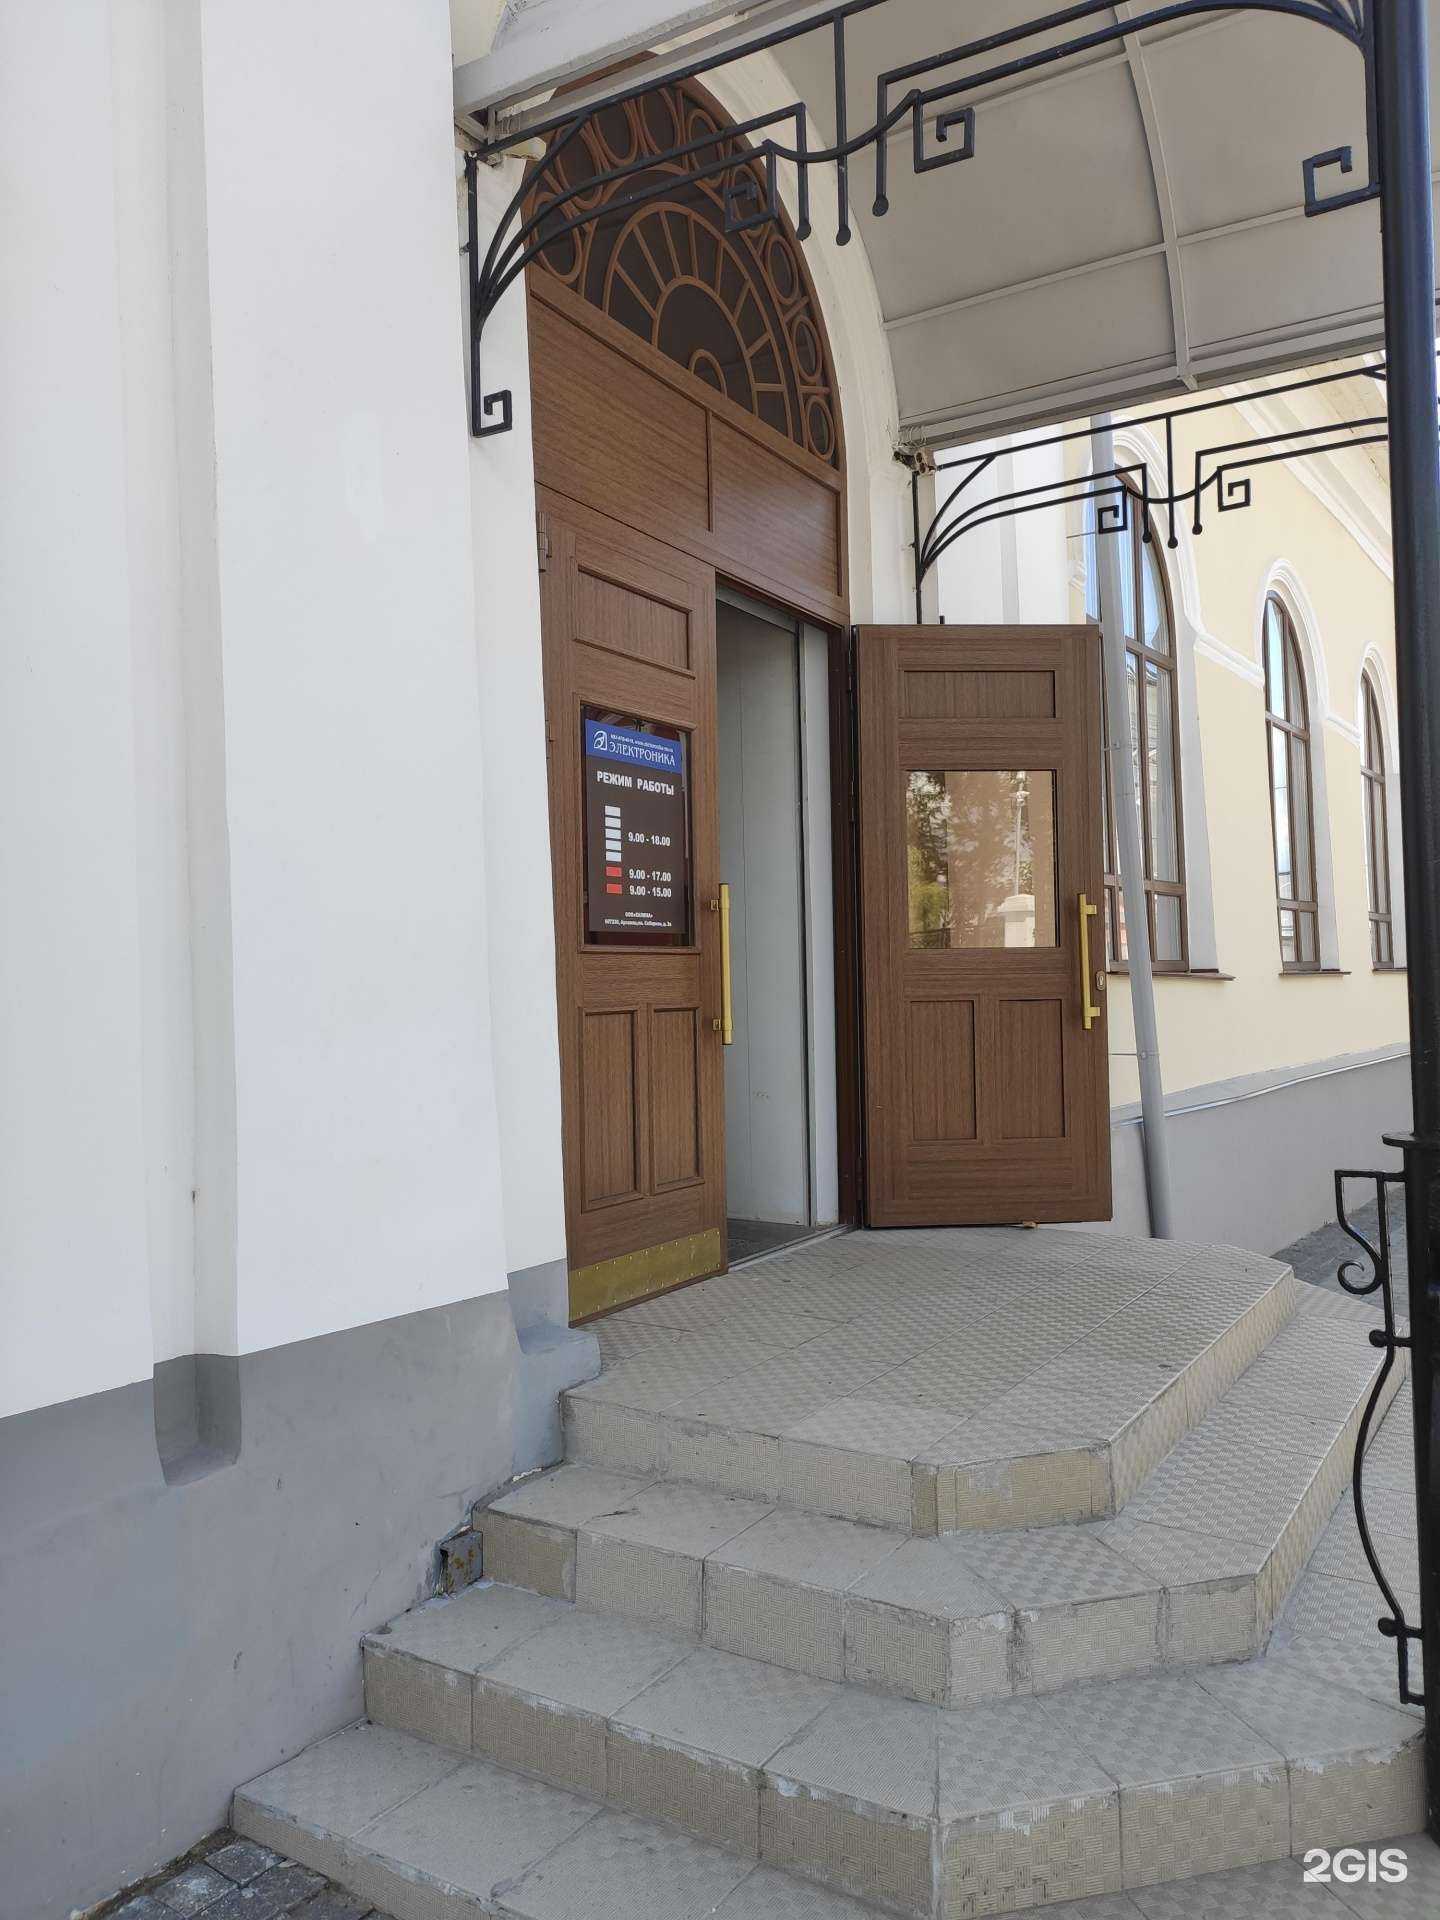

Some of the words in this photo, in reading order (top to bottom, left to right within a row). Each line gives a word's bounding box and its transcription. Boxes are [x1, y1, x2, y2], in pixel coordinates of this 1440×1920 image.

[609, 741, 676, 767] ЭЛЕКТРОНИКА
[597, 770, 633, 788] РЕЖИМ
[637, 778, 674, 796] РАБОТЫ
[628, 831, 645, 843] 9.00
[651, 835, 671, 847] 18.00
[629, 868, 646, 880] 9.00
[652, 871, 672, 882] 17.00
[629, 885, 646, 896] 9.00
[652, 887, 672, 898] 15.00
